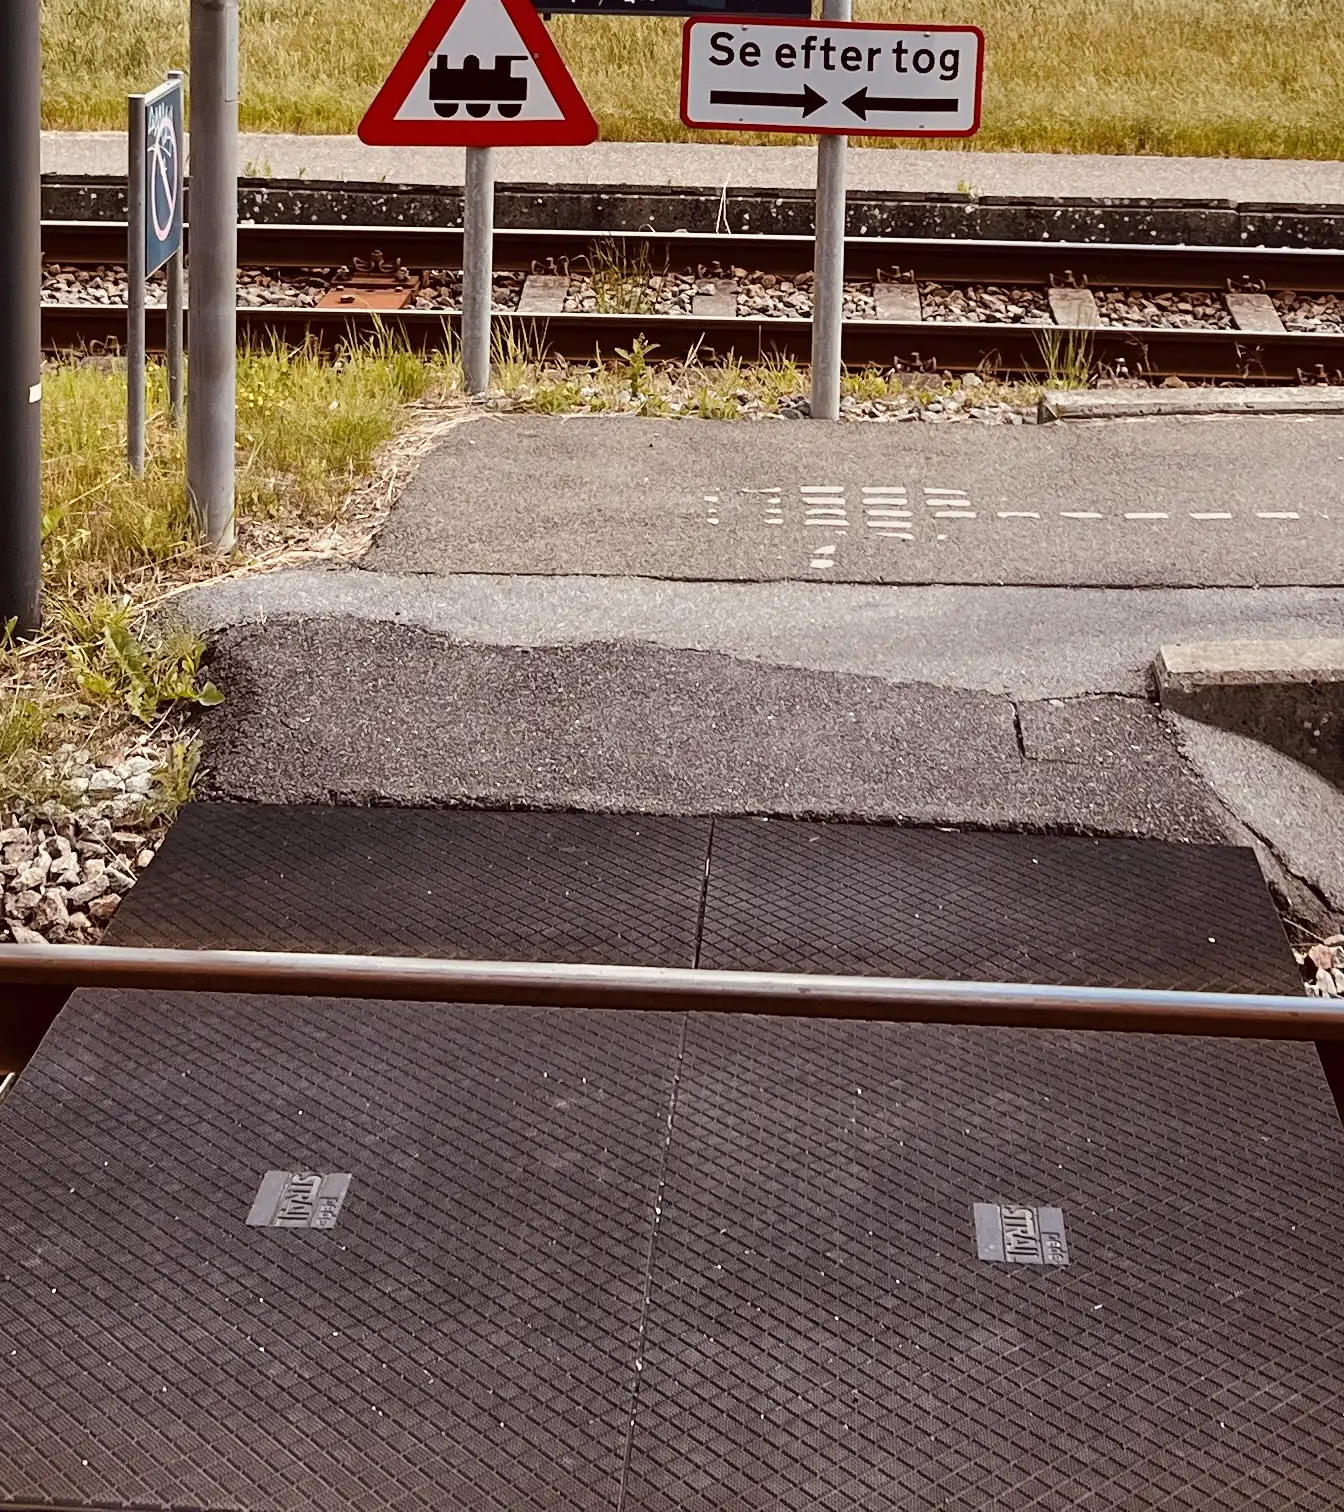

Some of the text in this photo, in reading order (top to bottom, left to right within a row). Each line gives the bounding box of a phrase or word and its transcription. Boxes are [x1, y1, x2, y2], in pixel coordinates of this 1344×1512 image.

[708, 31, 960, 81] Se efter tog
[1002, 1205, 1041, 1263] STRAIL
